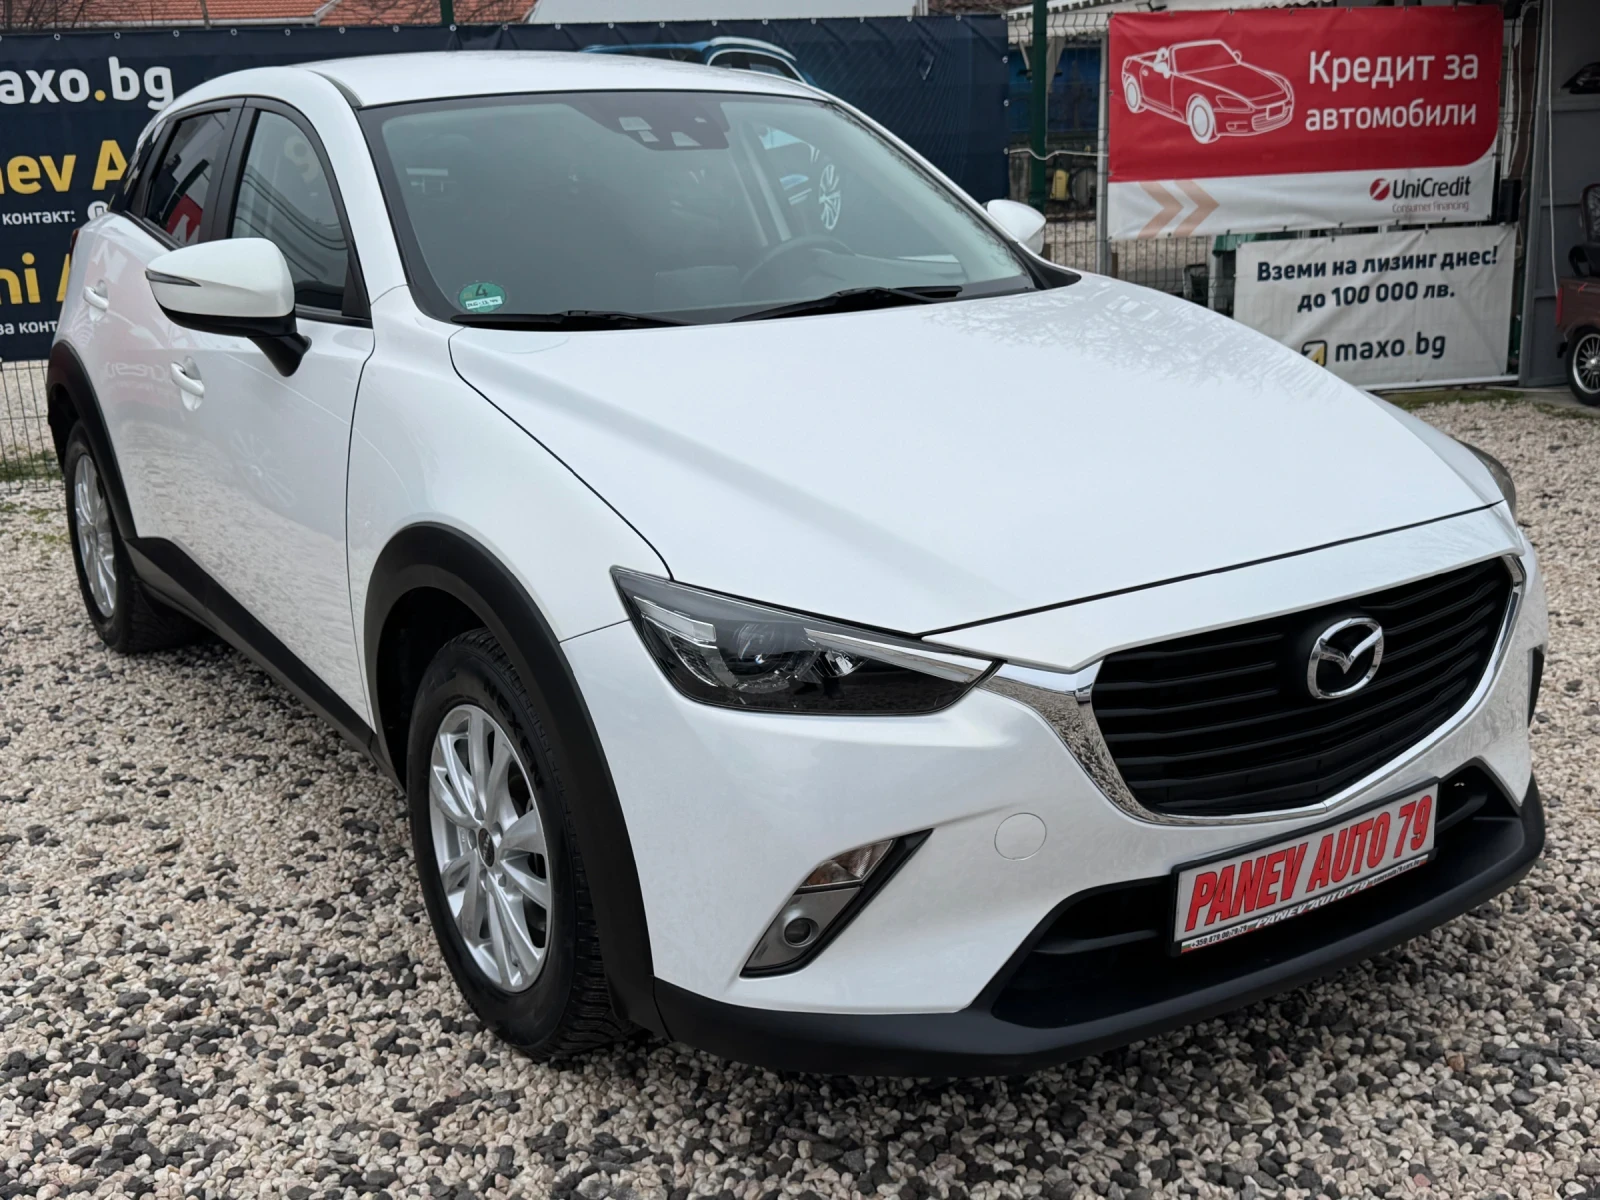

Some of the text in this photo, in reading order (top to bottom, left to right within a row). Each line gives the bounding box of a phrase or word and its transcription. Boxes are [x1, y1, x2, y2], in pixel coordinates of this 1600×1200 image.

[1309, 50, 1479, 92] Кредит за
[1305, 98, 1477, 131] автомобили
[0, 154, 77, 194] ev
[1392, 176, 1471, 199] UniCredit
[2, 210, 76, 225] контакт:
[1392, 202, 1431, 213] Consumer
[1257, 246, 1499, 281] Вземи на лизинг днес!
[1297, 281, 1455, 313] до 100 000 лв.
[1335, 331, 1446, 363] maxo.bg
[1184, 795, 1433, 932] PANEV AUTO 79
[1255, 904, 1307, 928] PANEV
[1309, 888, 1348, 910] AUTO
